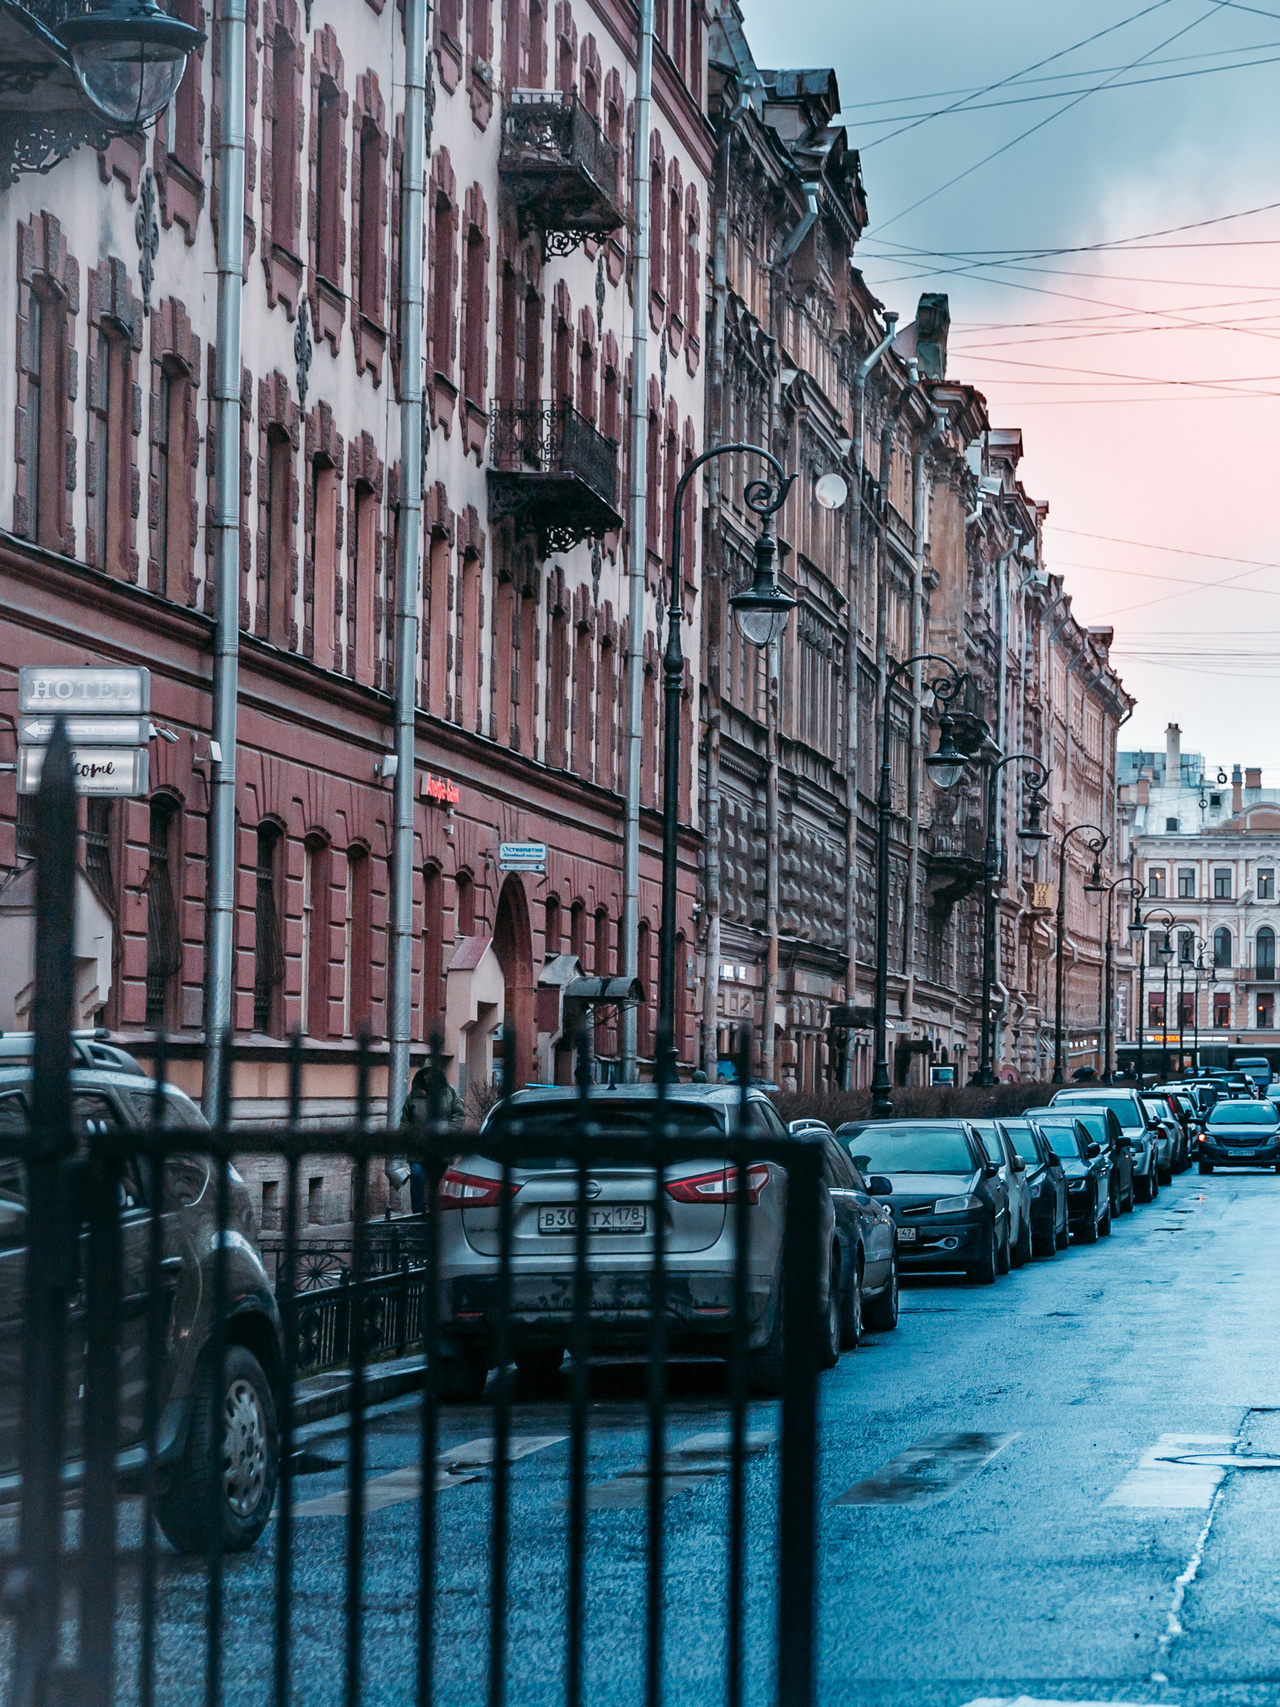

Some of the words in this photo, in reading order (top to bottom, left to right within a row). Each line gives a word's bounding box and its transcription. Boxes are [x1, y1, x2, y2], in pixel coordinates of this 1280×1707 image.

[31, 680, 133, 699] HOTEL
[545, 1209, 612, 1226] В30ТХ
[615, 1207, 640, 1220] 178
